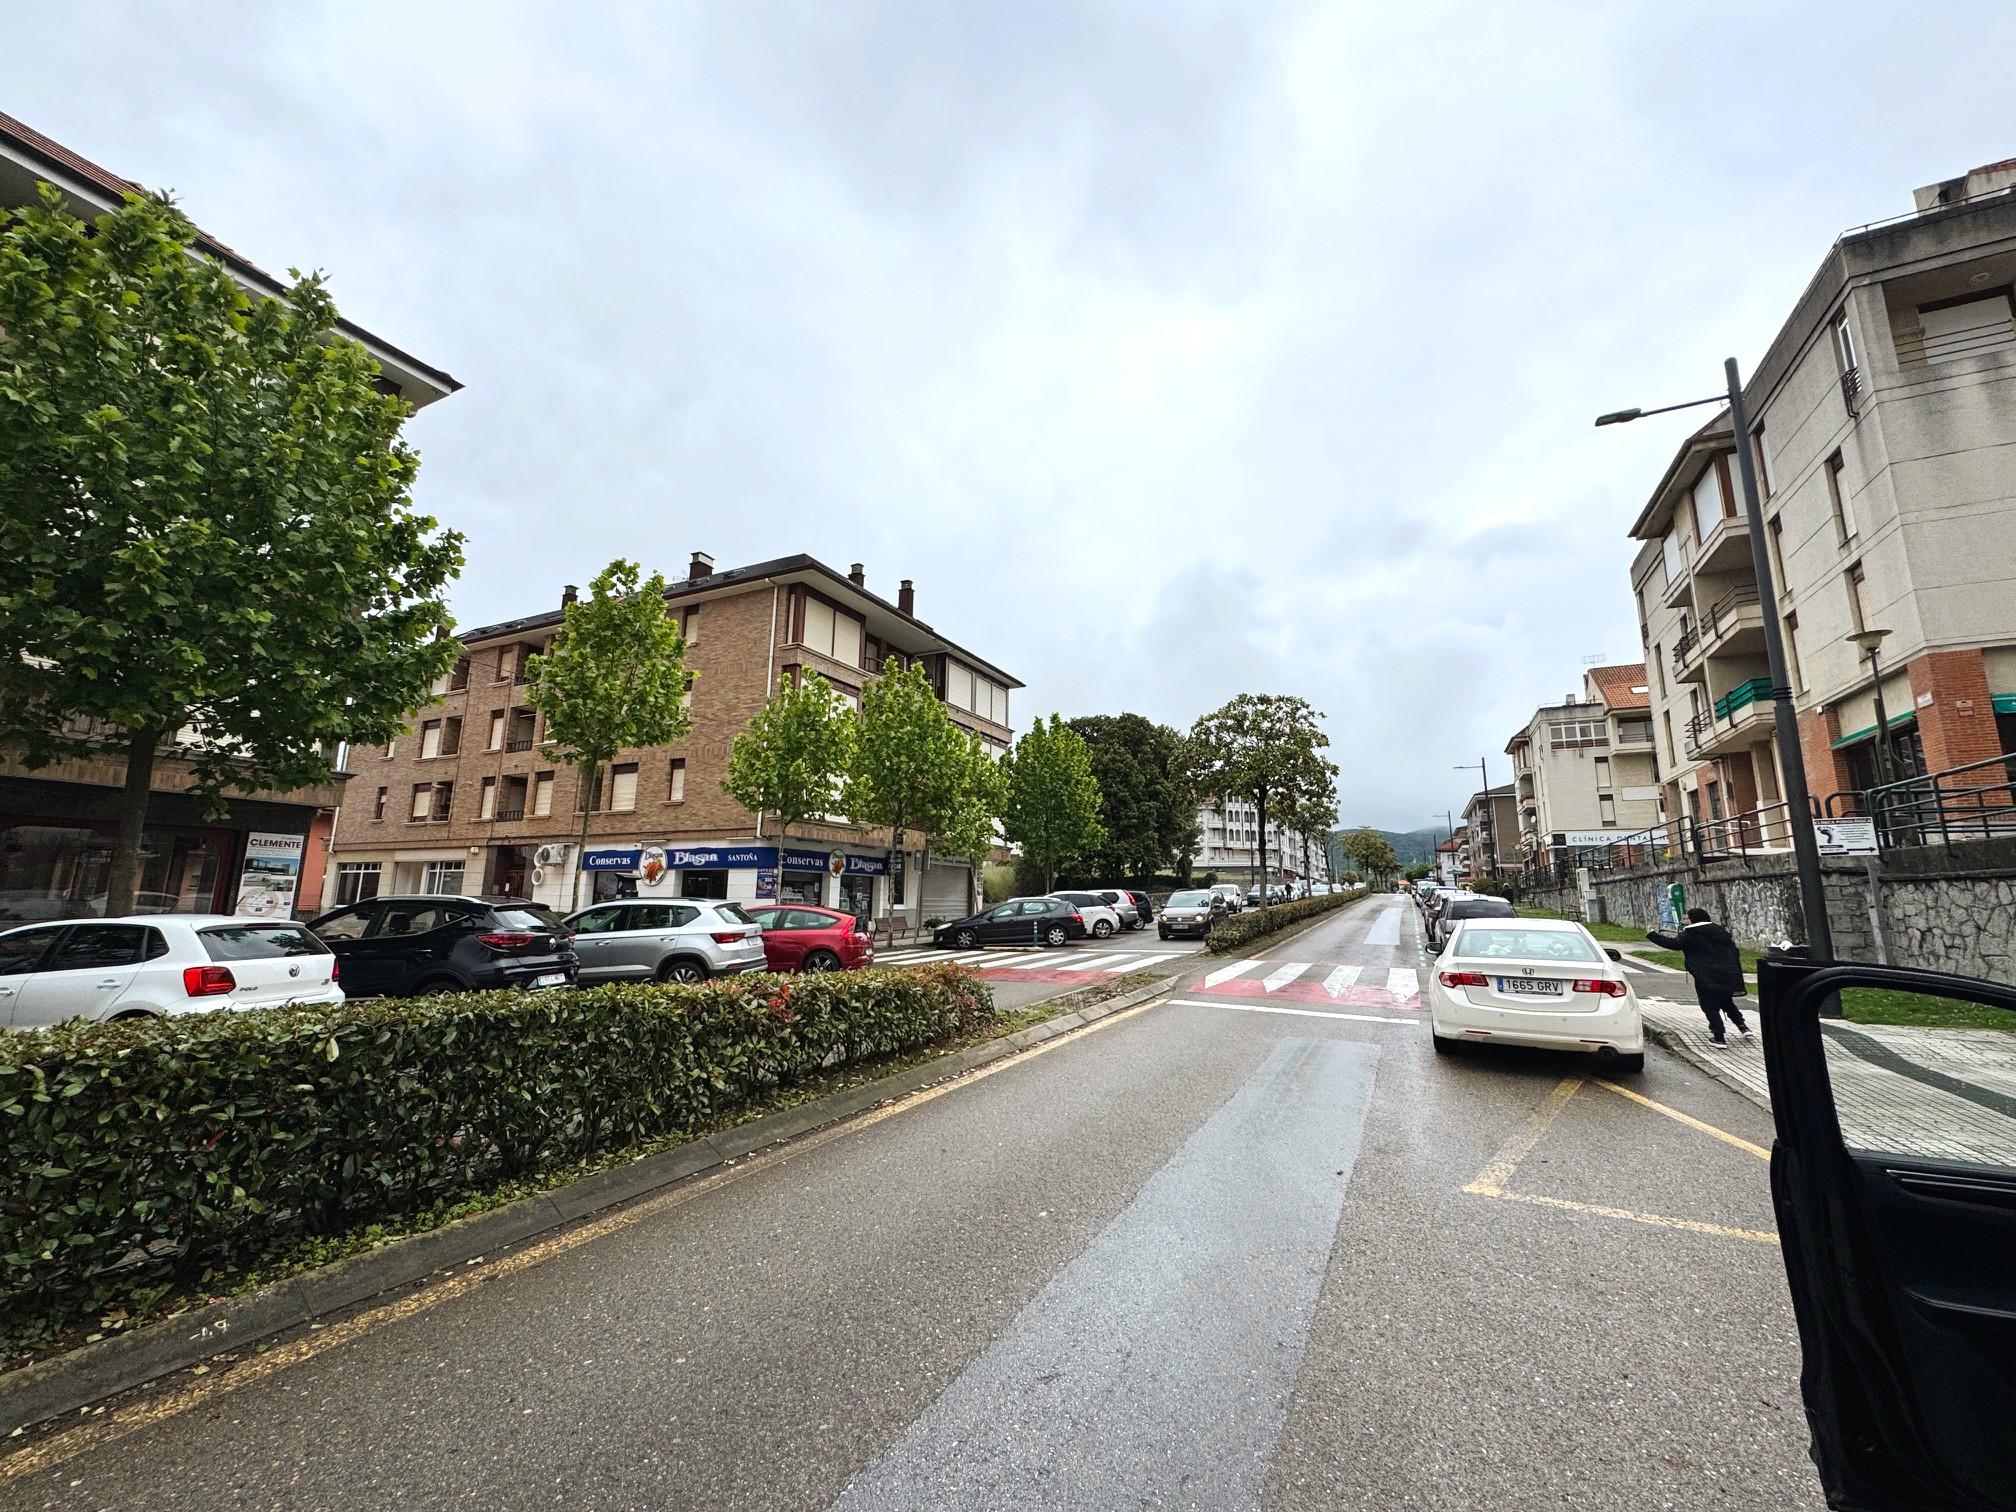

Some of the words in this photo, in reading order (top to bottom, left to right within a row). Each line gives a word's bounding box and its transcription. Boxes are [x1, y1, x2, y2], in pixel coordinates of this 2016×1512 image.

[250, 838, 302, 849] CLEMENTE
[589, 855, 631, 866] Conservas
[727, 852, 758, 861] SANTOÑA
[778, 853, 824, 867] Conservas
[1506, 979, 1534, 990] 1665
[1537, 981, 1559, 992] GRV
